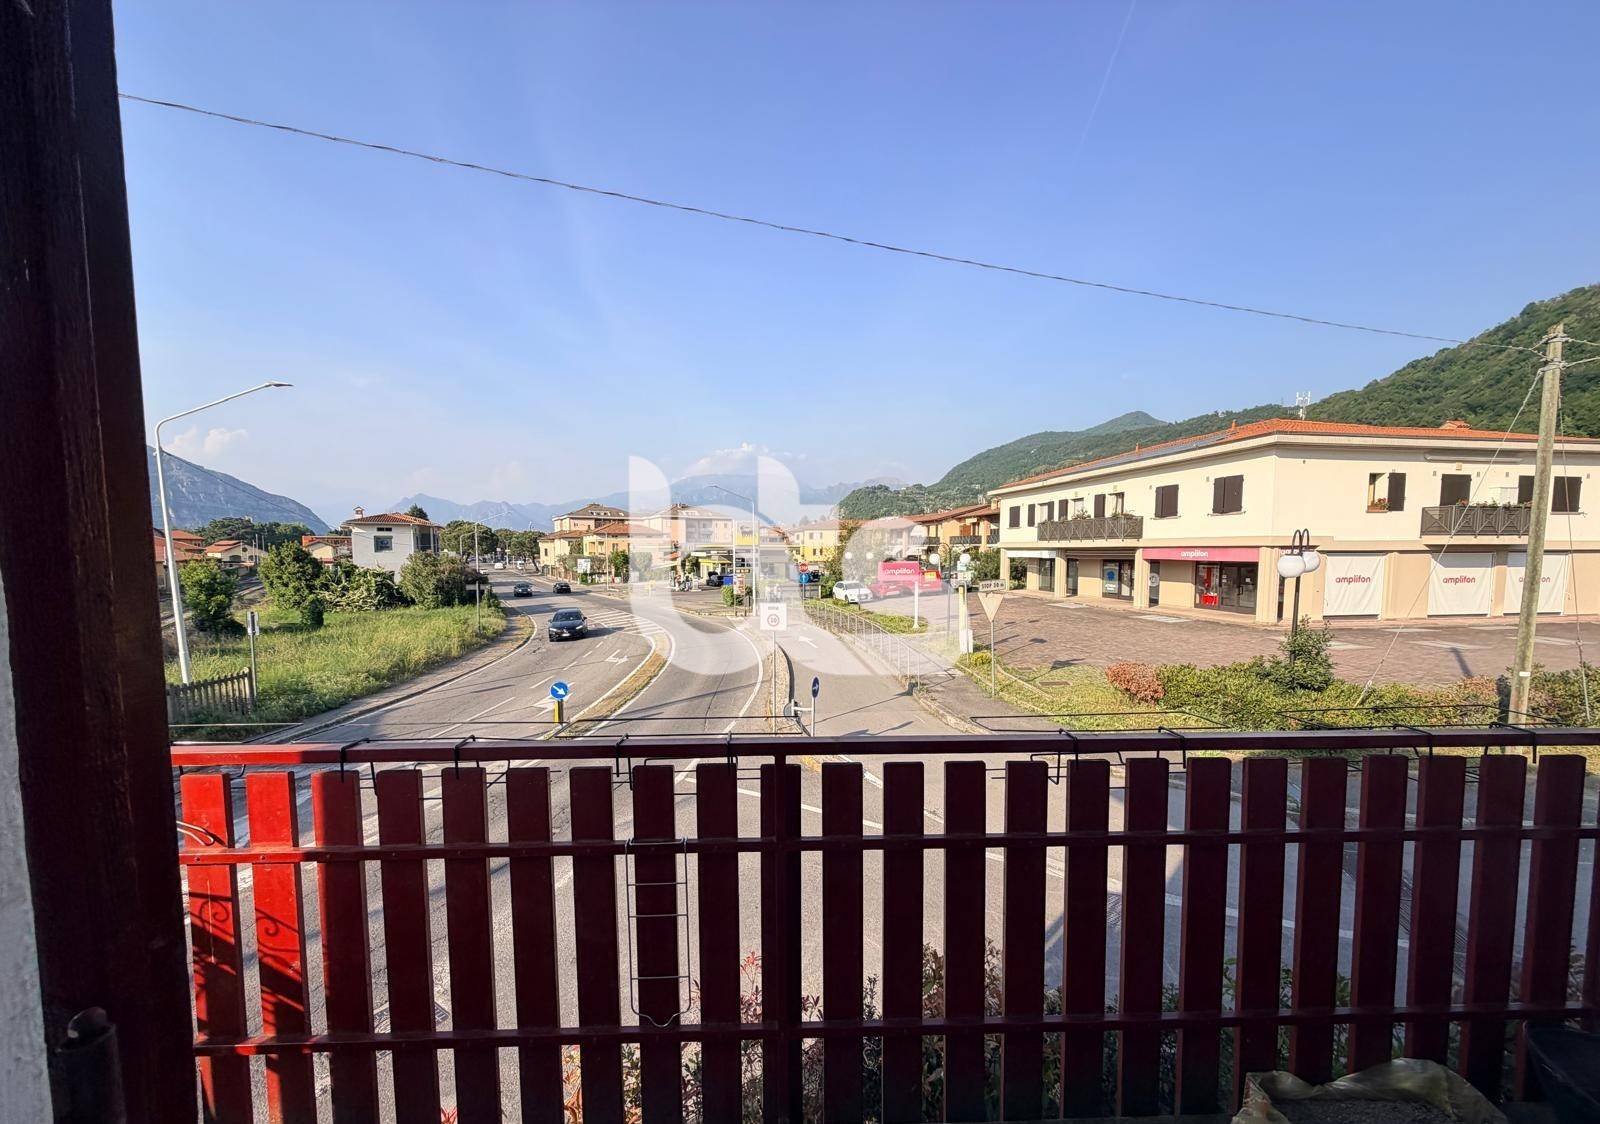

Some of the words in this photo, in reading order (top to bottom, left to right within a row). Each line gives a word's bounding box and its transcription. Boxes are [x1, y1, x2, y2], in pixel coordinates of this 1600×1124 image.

[1181, 549, 1209, 558] amplifon
[884, 567, 915, 576] amplifon
[1335, 574, 1371, 585] amplifon
[1442, 575, 1476, 585] amplifon
